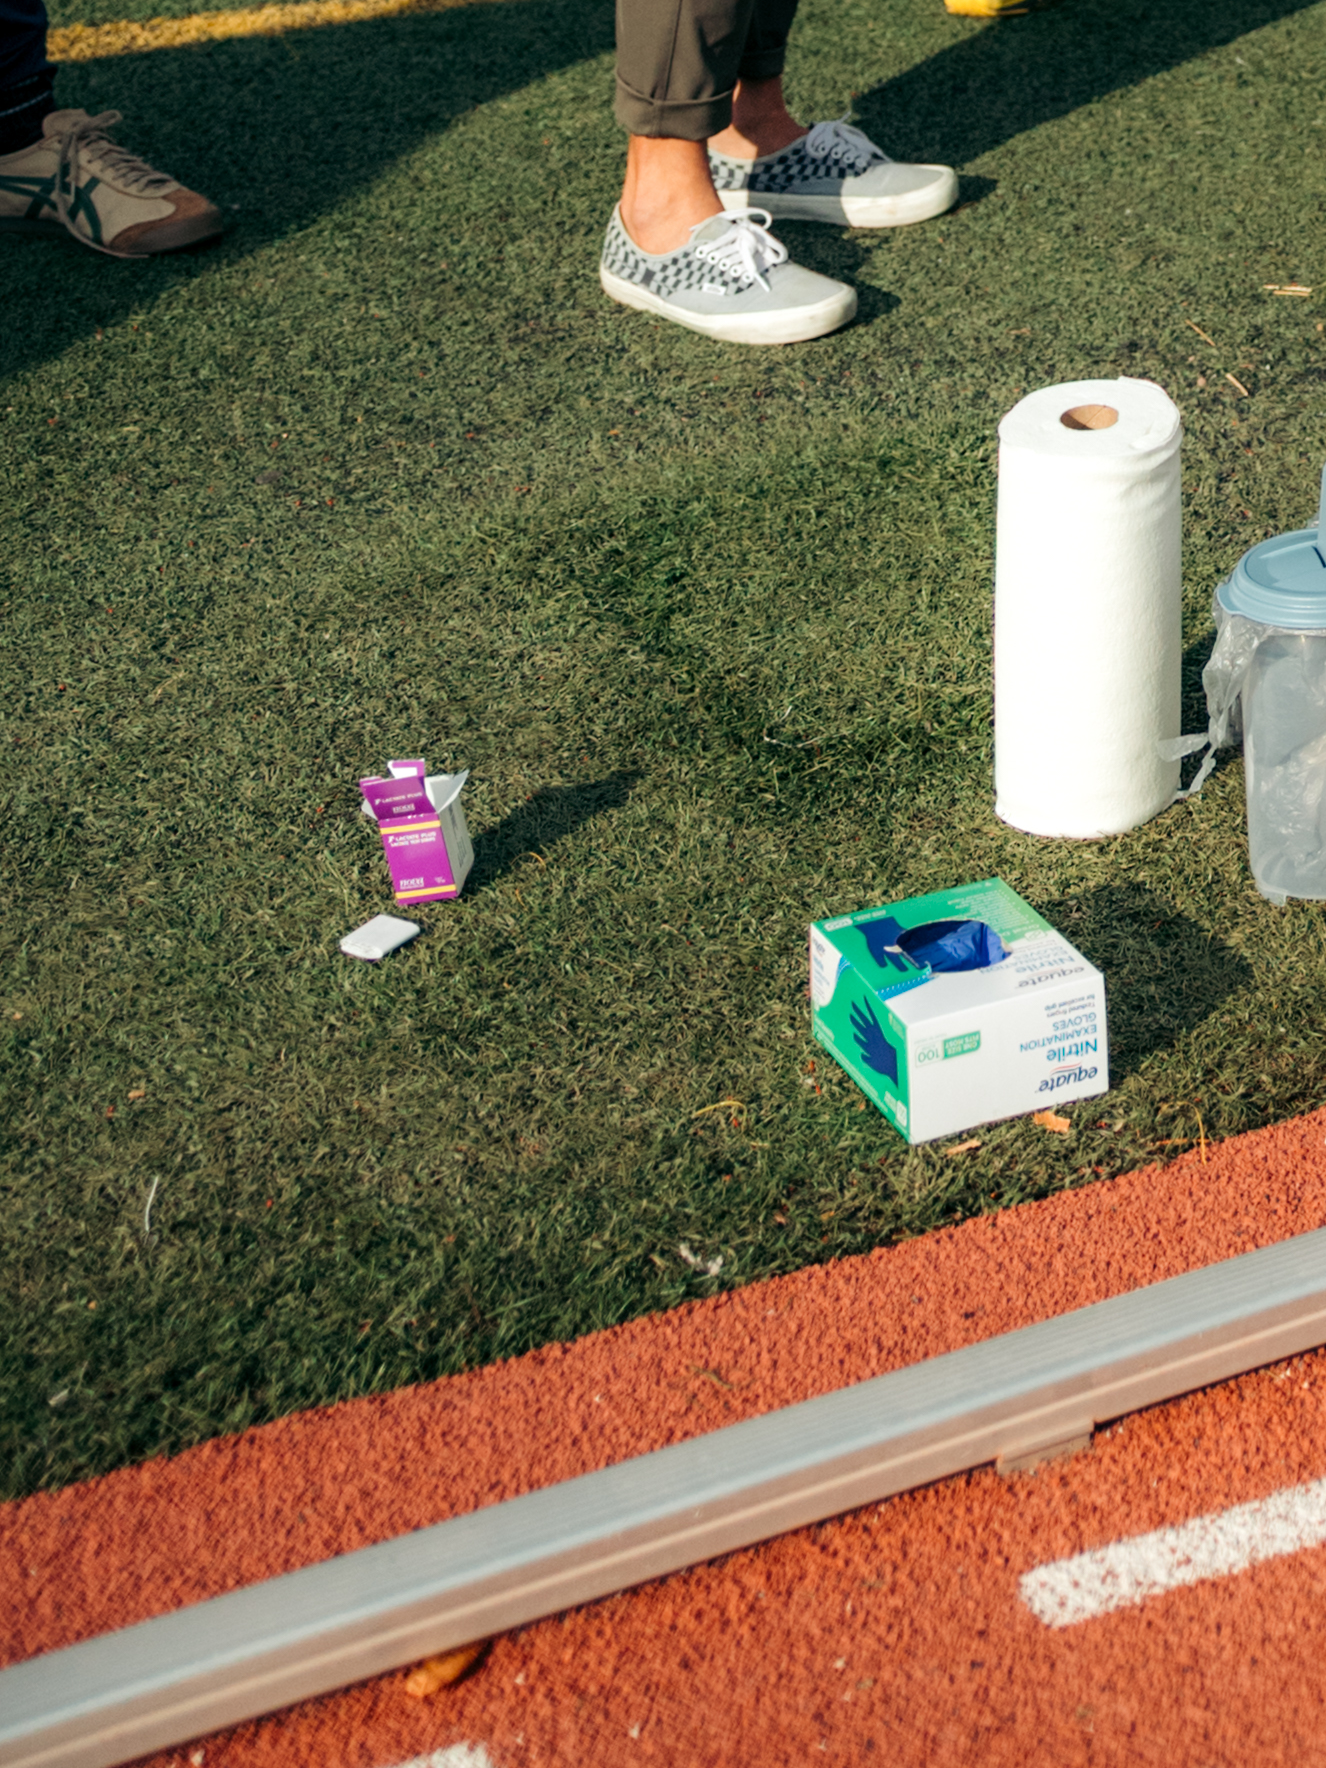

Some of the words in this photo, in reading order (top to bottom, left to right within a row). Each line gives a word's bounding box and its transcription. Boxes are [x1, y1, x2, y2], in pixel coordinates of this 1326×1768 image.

[1052, 1012, 1096, 1031] GLOVES
[1020, 1023, 1097, 1052] EXAMINATION
[918, 1048, 939, 1063] 100
[1046, 1038, 1098, 1062] Nitrile
[1038, 1066, 1098, 1092] equate
